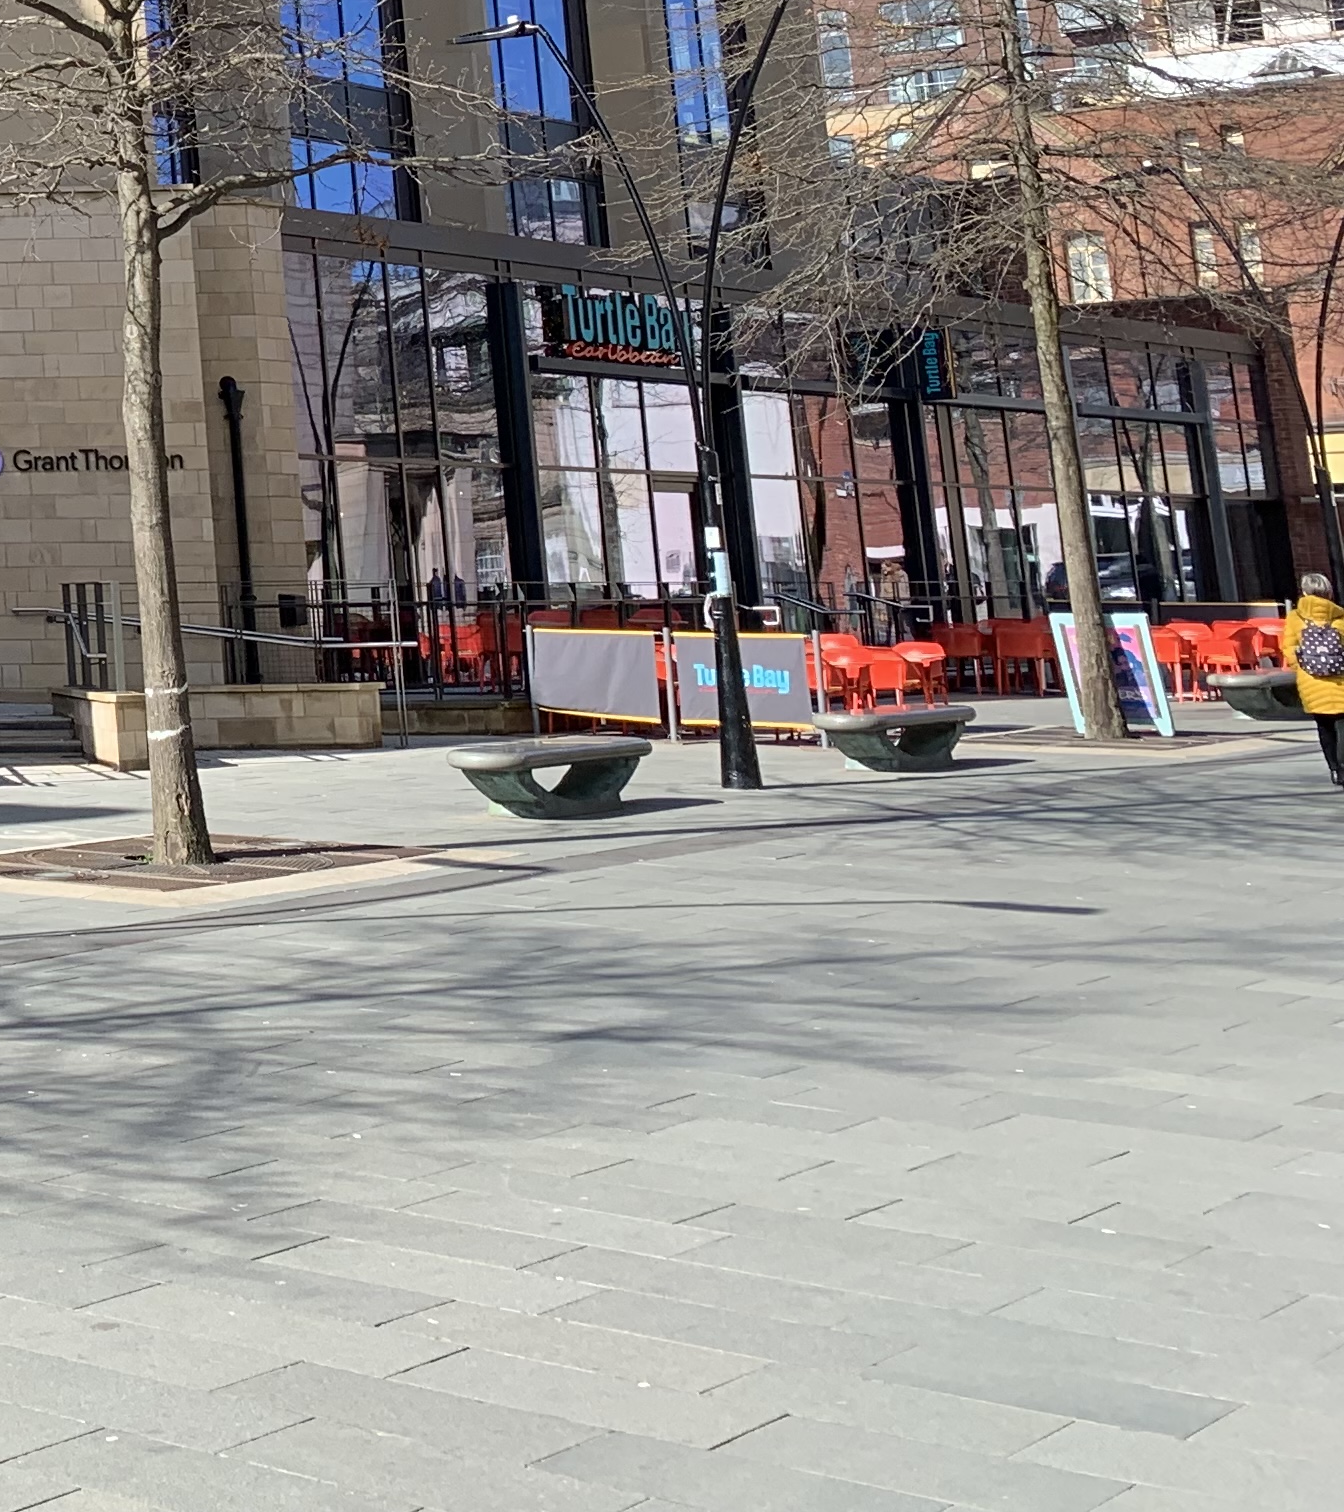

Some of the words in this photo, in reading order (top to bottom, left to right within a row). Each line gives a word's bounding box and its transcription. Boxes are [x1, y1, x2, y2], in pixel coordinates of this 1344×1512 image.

[561, 283, 641, 347] Turtle
[572, 341, 679, 364] Caribbean
[922, 332, 939, 356] Bay
[924, 357, 941, 395] Turtle
[13, 449, 79, 472] Grant
[79, 448, 184, 471] Thon
[693, 663, 750, 687] Tue
[752, 664, 790, 695] Bay
